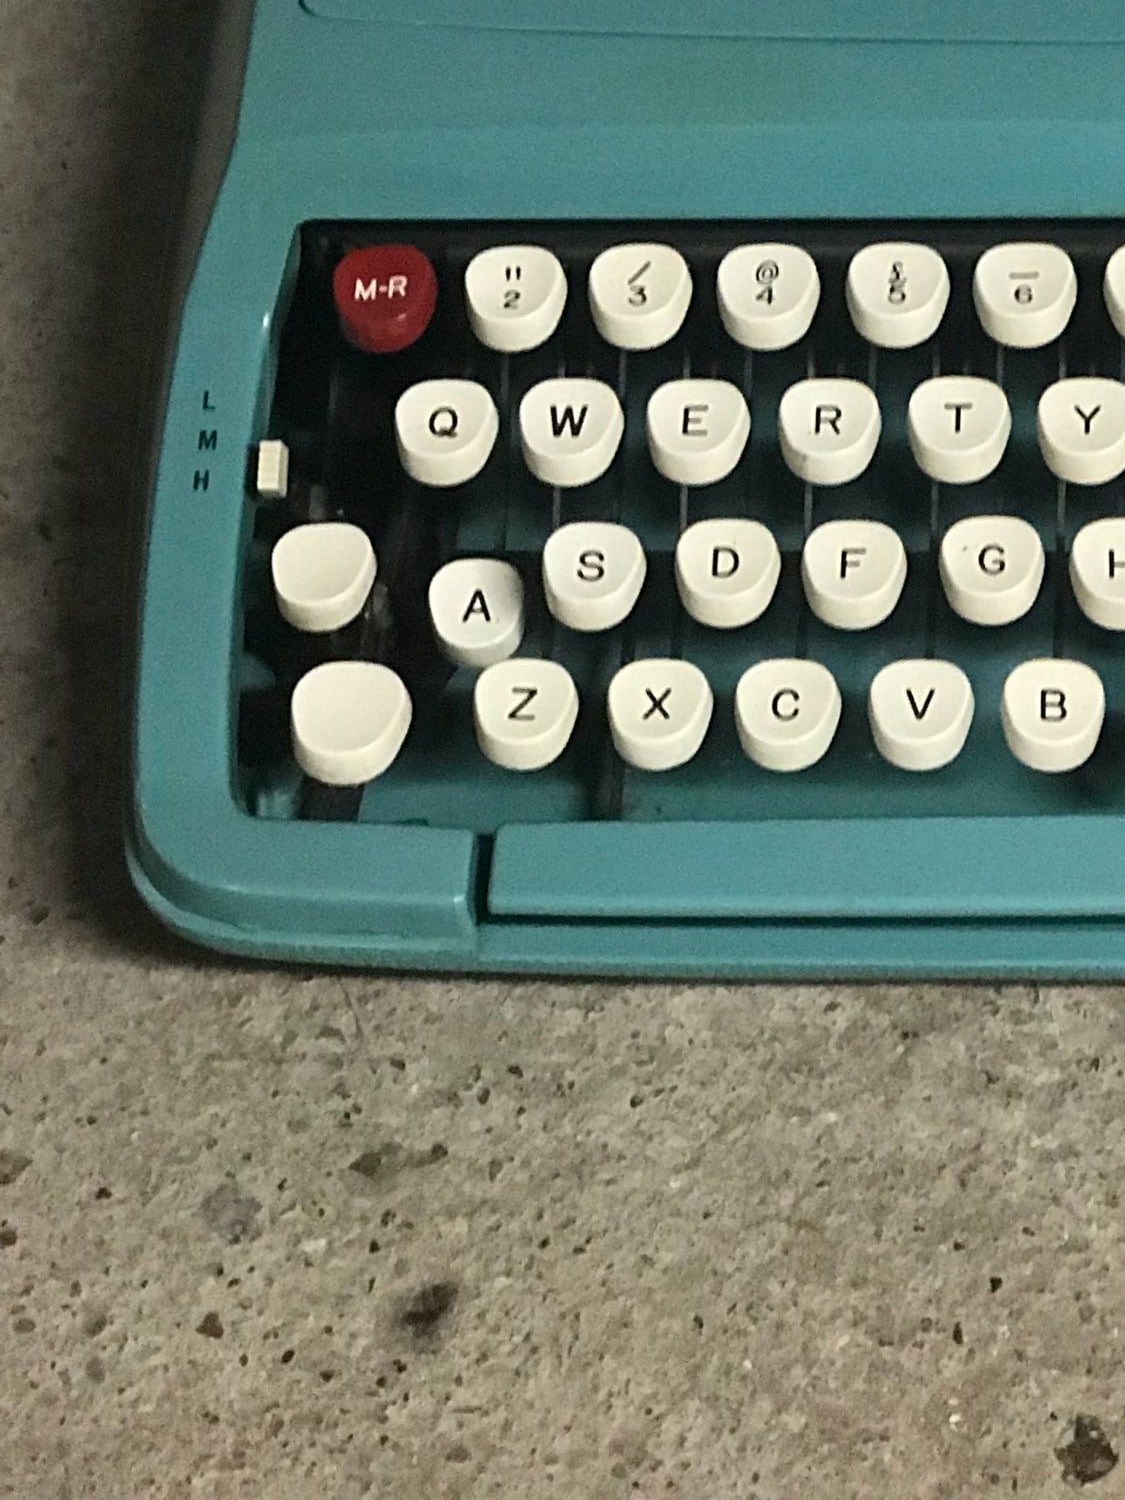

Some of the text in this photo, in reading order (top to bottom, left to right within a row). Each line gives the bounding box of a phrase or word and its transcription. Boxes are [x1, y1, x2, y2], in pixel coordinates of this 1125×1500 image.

[354, 275, 408, 301] M-R
[755, 260, 779, 285] @
[503, 289, 522, 310] 2
[627, 284, 648, 307] 3
[756, 285, 774, 305] 4
[888, 283, 906, 305] 5
[1014, 284, 1033, 304] 6
[203, 390, 216, 410] L
[428, 406, 459, 440] Q
[549, 404, 589, 439] W
[681, 404, 709, 437] E
[814, 404, 843, 436] R
[943, 402, 973, 435] T
[1073, 404, 1102, 436] Y
[198, 430, 217, 450] M
[193, 470, 209, 491] H
[576, 549, 606, 583] S
[711, 545, 740, 579] D
[839, 547, 867, 580] F
[977, 543, 1006, 577] G
[461, 588, 492, 624] A
[507, 686, 538, 722] Z
[642, 687, 672, 721] X
[771, 687, 800, 722] C
[905, 687, 936, 722] V
[1039, 688, 1068, 723] B
